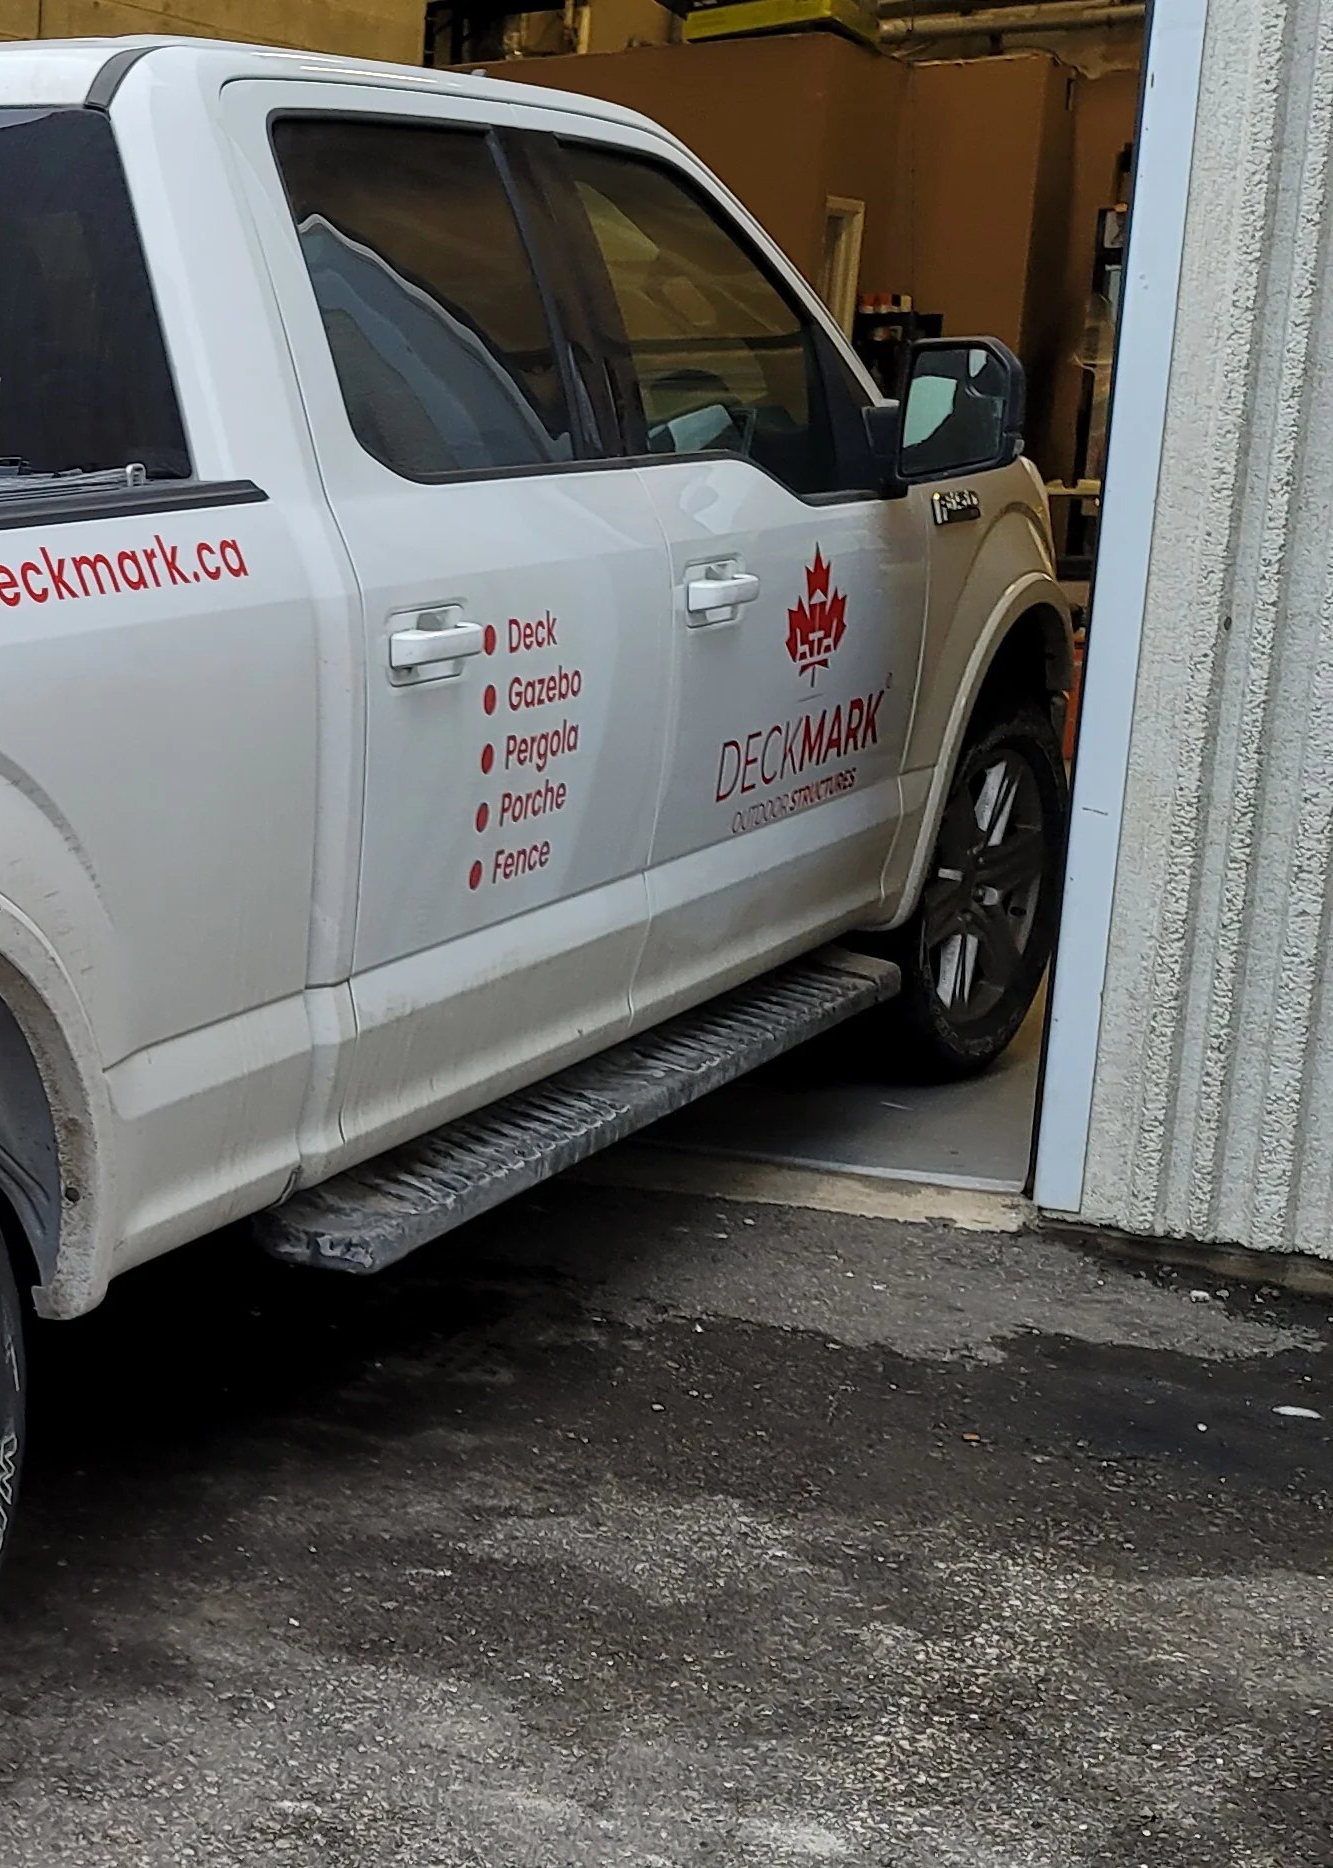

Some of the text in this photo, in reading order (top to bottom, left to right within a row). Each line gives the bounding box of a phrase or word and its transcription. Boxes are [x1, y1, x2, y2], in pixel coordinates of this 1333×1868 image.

[507, 609, 558, 655] Deck
[507, 664, 582, 712] Gazebo
[504, 718, 580, 773] Pergola
[499, 778, 567, 828] Porche
[491, 839, 551, 885] Fence
